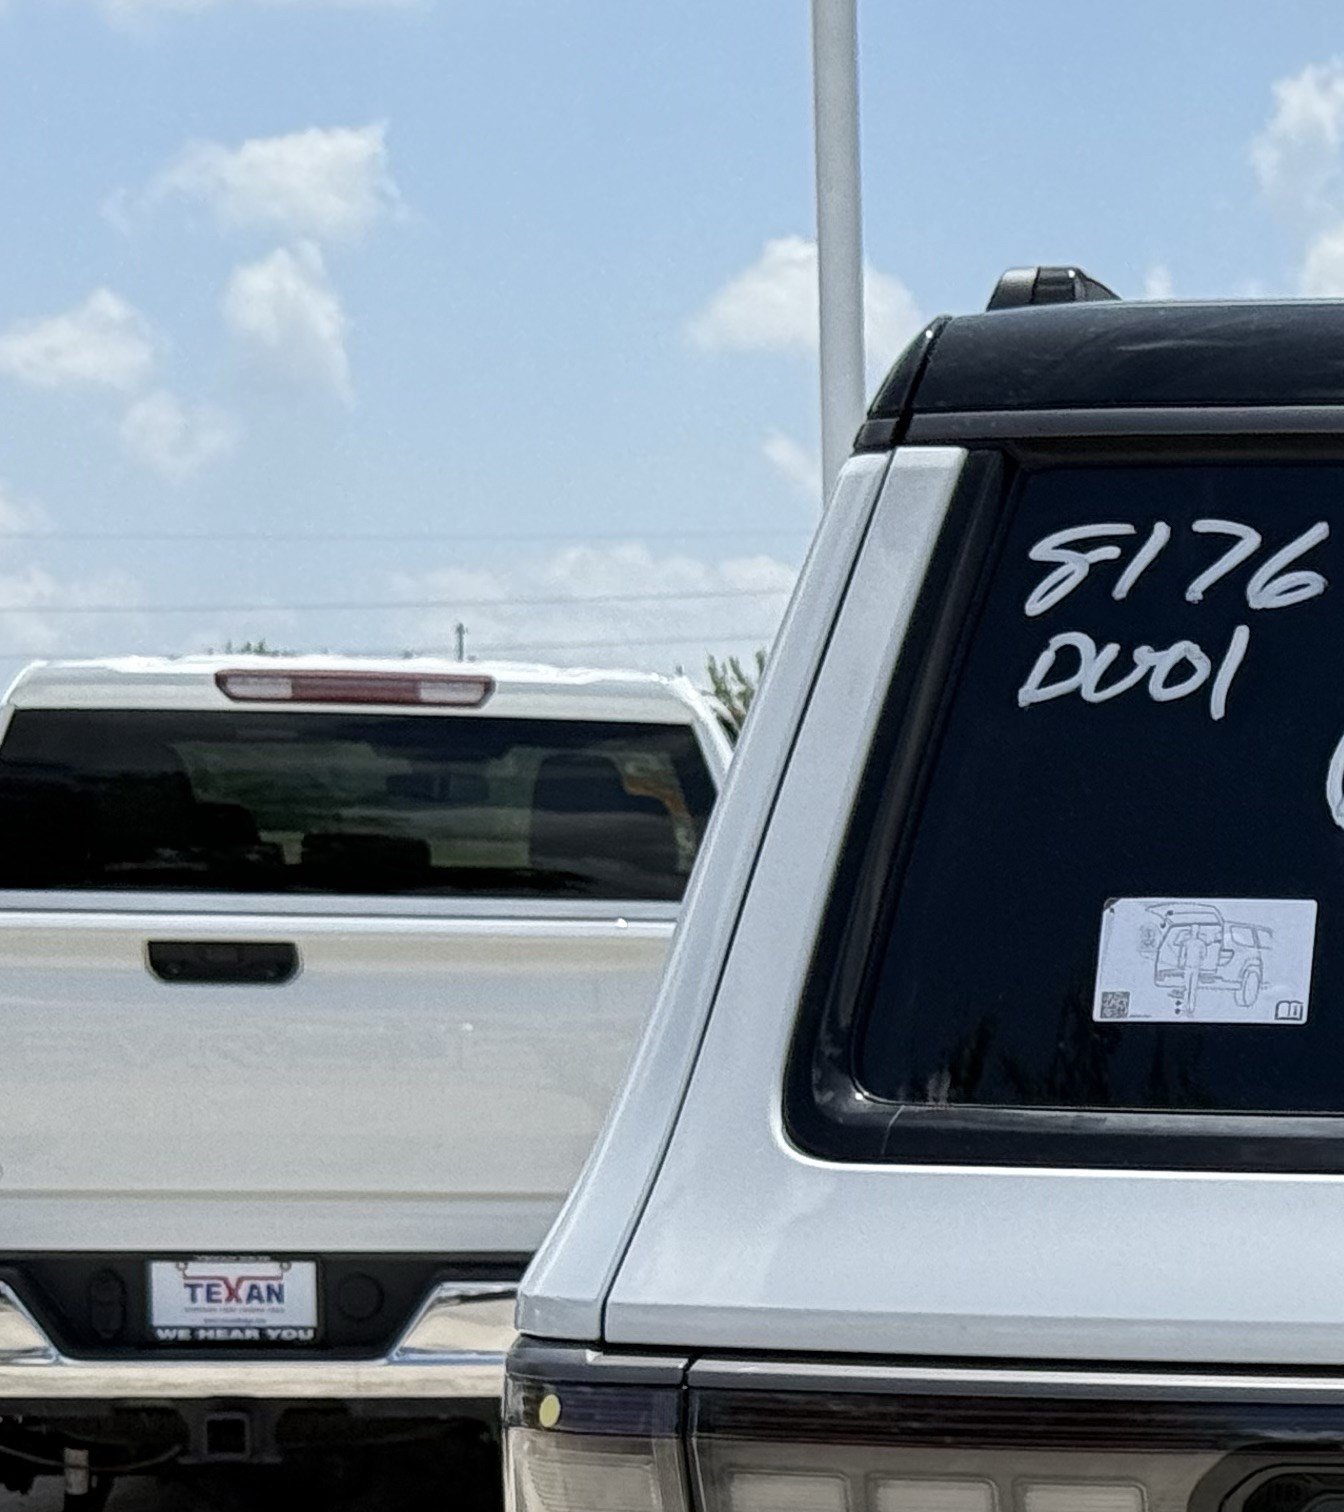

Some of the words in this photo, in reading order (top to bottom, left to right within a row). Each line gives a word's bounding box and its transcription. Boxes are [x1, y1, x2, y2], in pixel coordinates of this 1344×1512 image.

[1025, 519, 1329, 617] 8176
[184, 1276, 285, 1304] TEXAN
[156, 1329, 191, 1340] WE
[197, 1329, 260, 1340] HEAR
[266, 1329, 314, 1340] YOU
